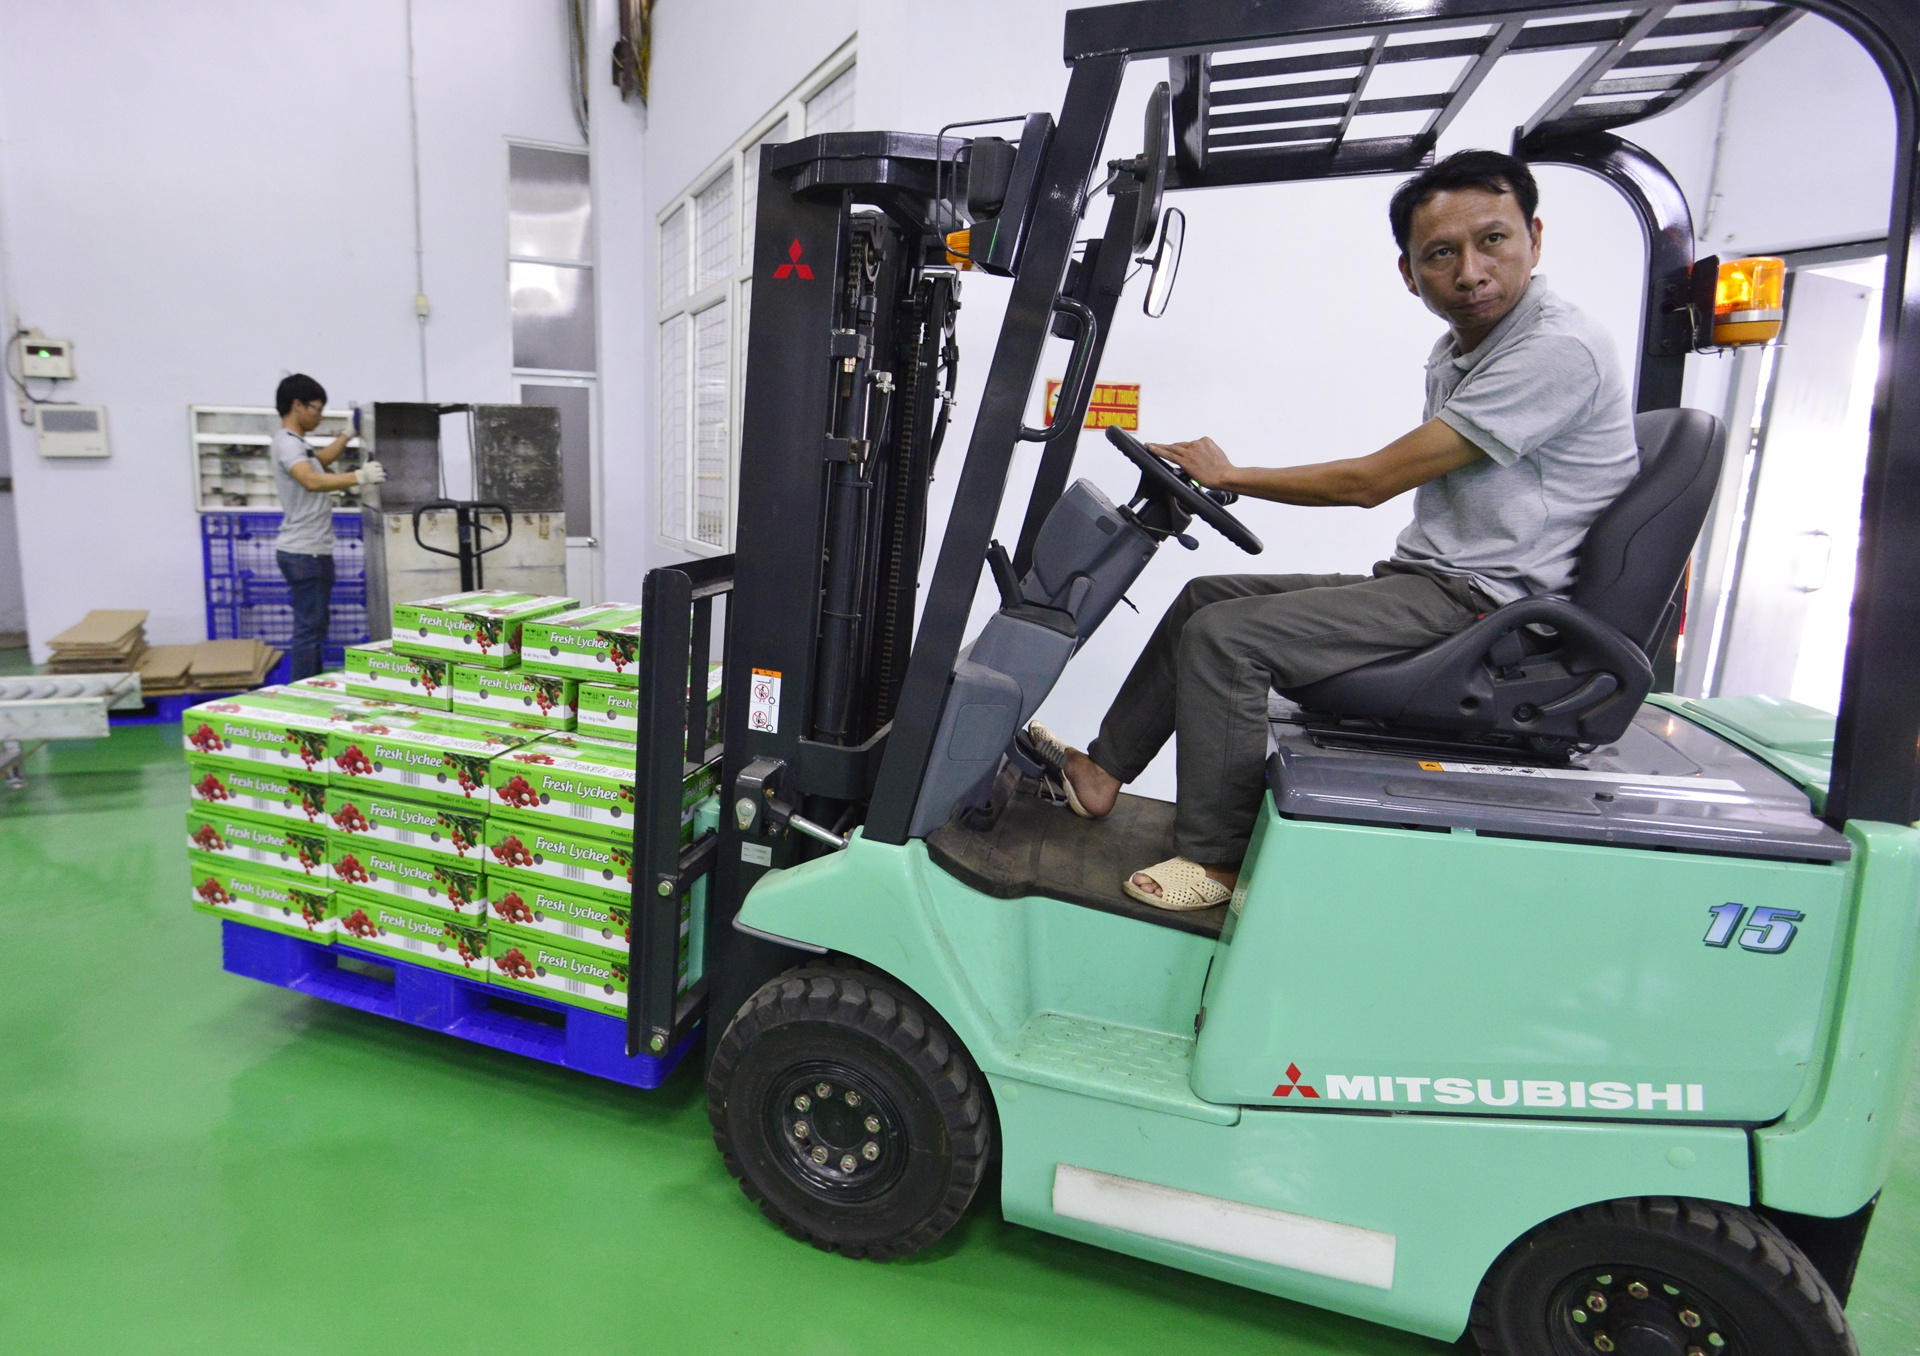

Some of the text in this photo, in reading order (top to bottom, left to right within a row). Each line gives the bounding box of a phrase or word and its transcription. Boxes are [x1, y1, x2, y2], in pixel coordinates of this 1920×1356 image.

[1097, 411, 1138, 429] SMOKING
[419, 613, 475, 632] Fresh Lychee
[550, 631, 610, 649] Fresh Lychee
[368, 657, 420, 674] Fresh Lychee
[479, 675, 535, 693] Fresh Lychee
[607, 695, 633, 709] Fresh
[224, 722, 286, 744] Fresh Lychee
[374, 744, 443, 768] Fresh Lychee
[228, 773, 289, 795] Fresh Lychee
[542, 775, 618, 802] Fresh Lychee
[370, 803, 437, 827] Fresh Lychee
[225, 823, 286, 847] Fresh Lychee
[535, 836, 610, 864] Fresh Lychee
[370, 855, 433, 882] Fresh Lychee
[230, 877, 289, 903] Fresh Lychee
[535, 894, 608, 923] Fresh Lychee
[378, 910, 443, 937] Fresh Lychee
[1702, 902, 1806, 955] 15
[537, 949, 610, 980] Fresh Lychee
[1325, 1074, 1705, 1111] MITSUBISHI
